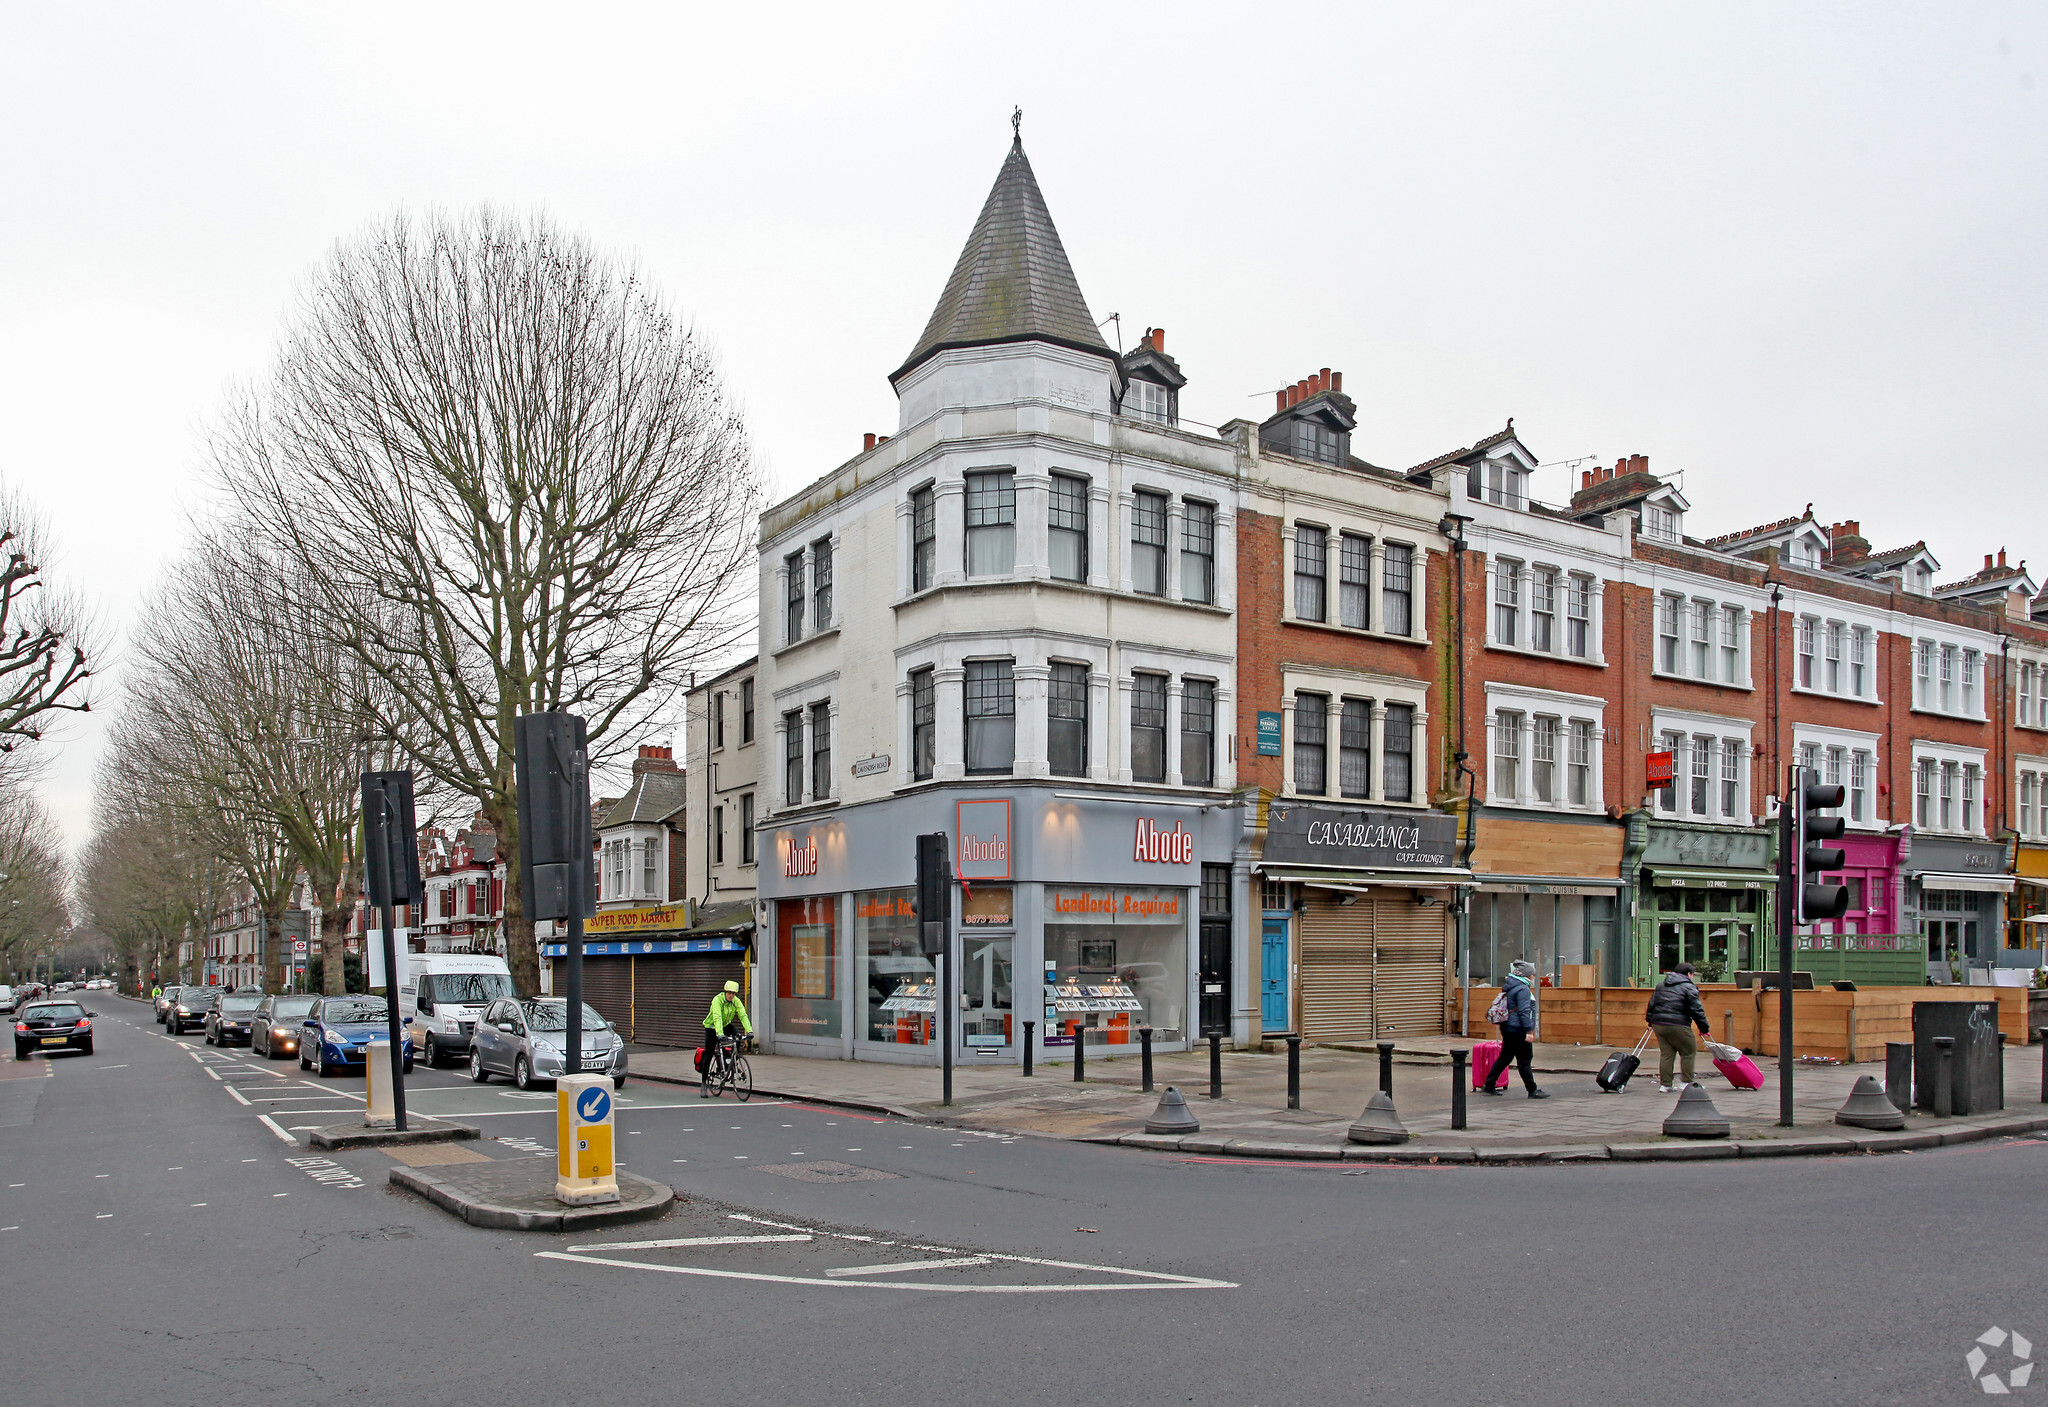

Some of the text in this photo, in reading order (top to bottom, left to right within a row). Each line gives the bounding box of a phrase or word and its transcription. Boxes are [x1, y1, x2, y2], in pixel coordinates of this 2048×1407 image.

[857, 763, 877, 774] CAVENDISH
[876, 761, 888, 770] ROAD
[1647, 761, 1671, 778] Abode
[1134, 817, 1193, 864] Abode
[1307, 821, 1420, 850] CASABLANCA
[1648, 829, 1760, 854] PIZZERIA
[962, 834, 1006, 861] Abode
[784, 836, 818, 878] Abode
[1396, 852, 1445, 864] CAFE LOUNGE
[1512, 885, 1527, 893] FINE
[1552, 886, 1578, 894] CUISINE
[1671, 879, 1686, 887] PIZZA
[1706, 880, 1714, 888] 1/2
[1745, 881, 1761, 889] PASTA
[857, 897, 894, 918] Landlords
[1055, 892, 1178, 918] Landlords Required
[590, 910, 677, 927] SUPER FOOD MARKET
[580, 1141, 586, 1149] 9
